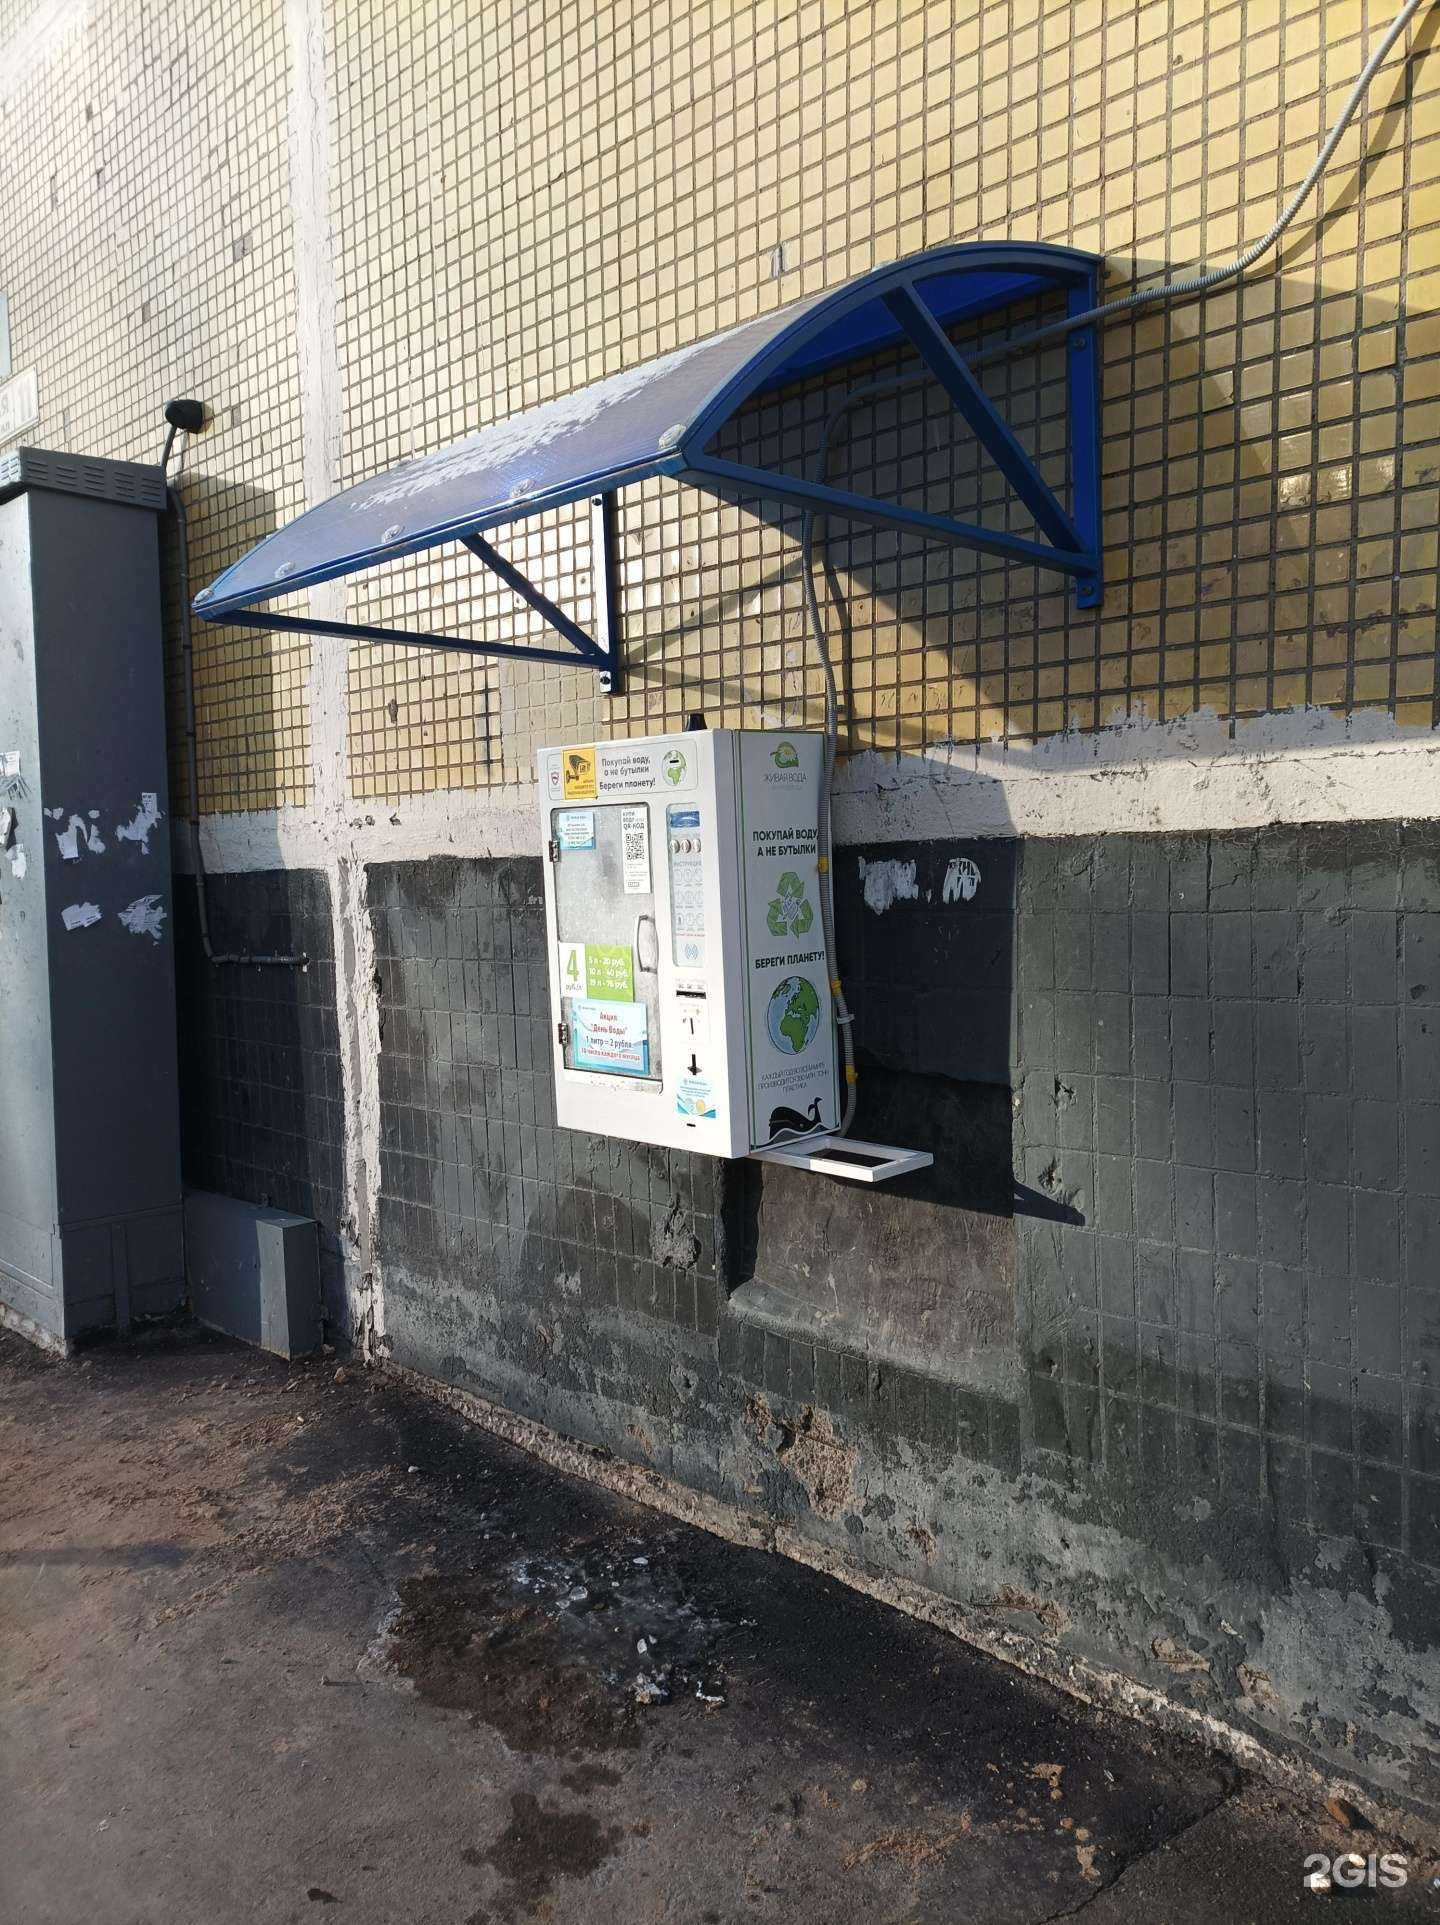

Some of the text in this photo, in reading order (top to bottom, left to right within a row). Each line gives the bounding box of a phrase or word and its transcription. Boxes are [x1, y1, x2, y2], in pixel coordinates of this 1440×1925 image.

[620, 765, 649, 776] бутылки
[600, 781, 623, 791] Береги
[624, 777, 656, 790] планету!
[752, 828, 794, 841] ПОКУПАЙ
[757, 843, 816, 857] А НЕ БУТЫЛКИ
[567, 949, 579, 981] 4
[755, 951, 825, 969] БЕРЕГИ ПЛАНЕТУ!
